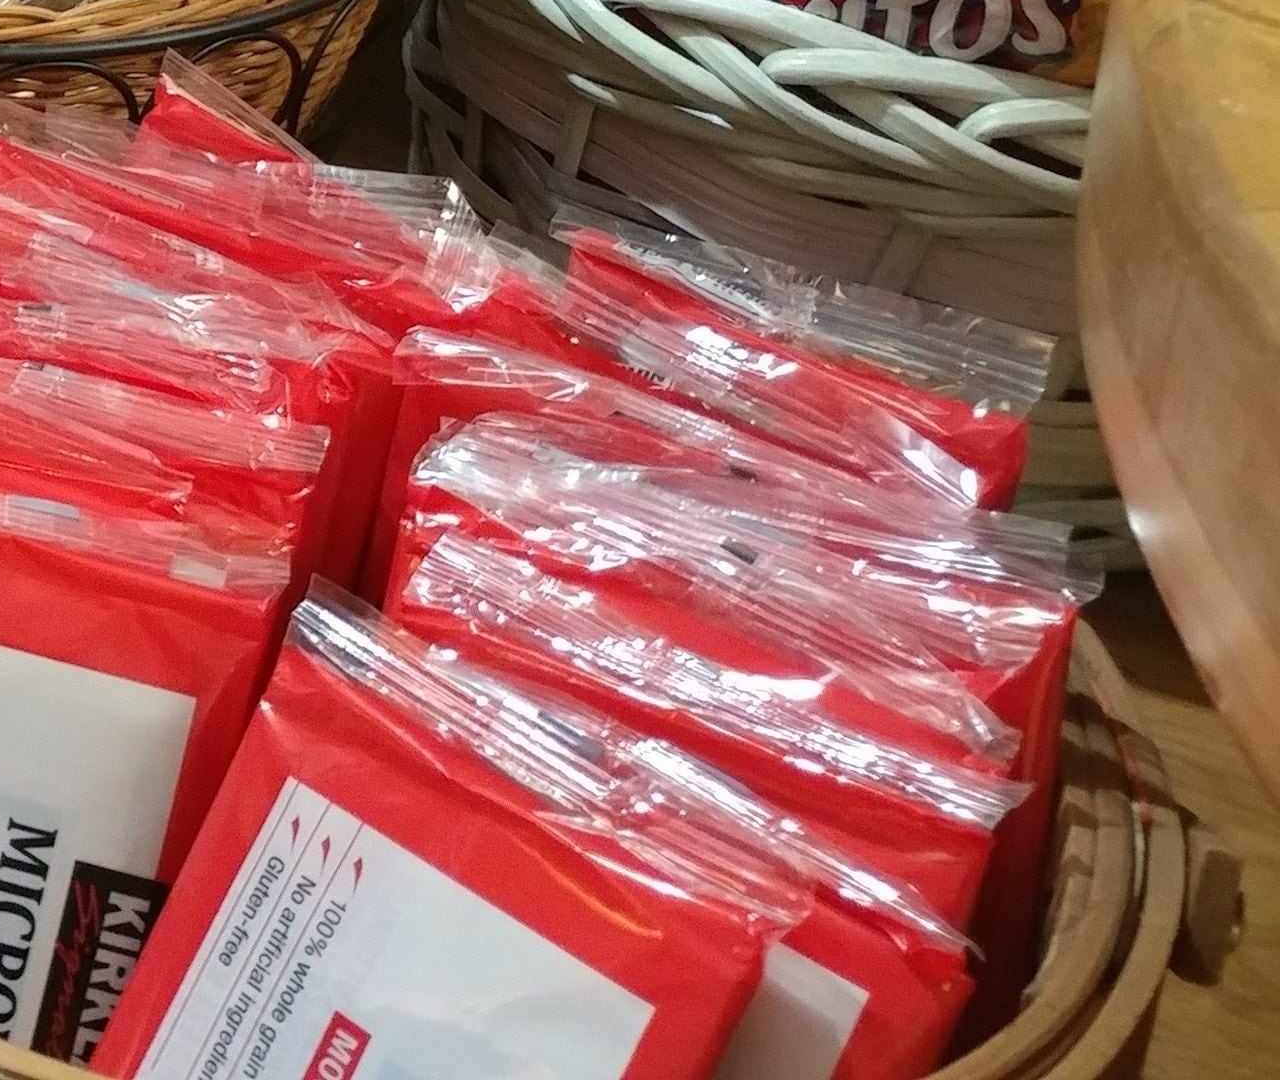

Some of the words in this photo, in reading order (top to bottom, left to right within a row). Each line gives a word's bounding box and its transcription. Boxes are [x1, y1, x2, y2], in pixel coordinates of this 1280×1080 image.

[217, 854, 288, 969] Gluten-free
[296, 872, 318, 906] No
[246, 897, 297, 996] artificial
[302, 898, 350, 961] 100%
[271, 958, 314, 1024] whole
[192, 989, 250, 1080] ingredien
